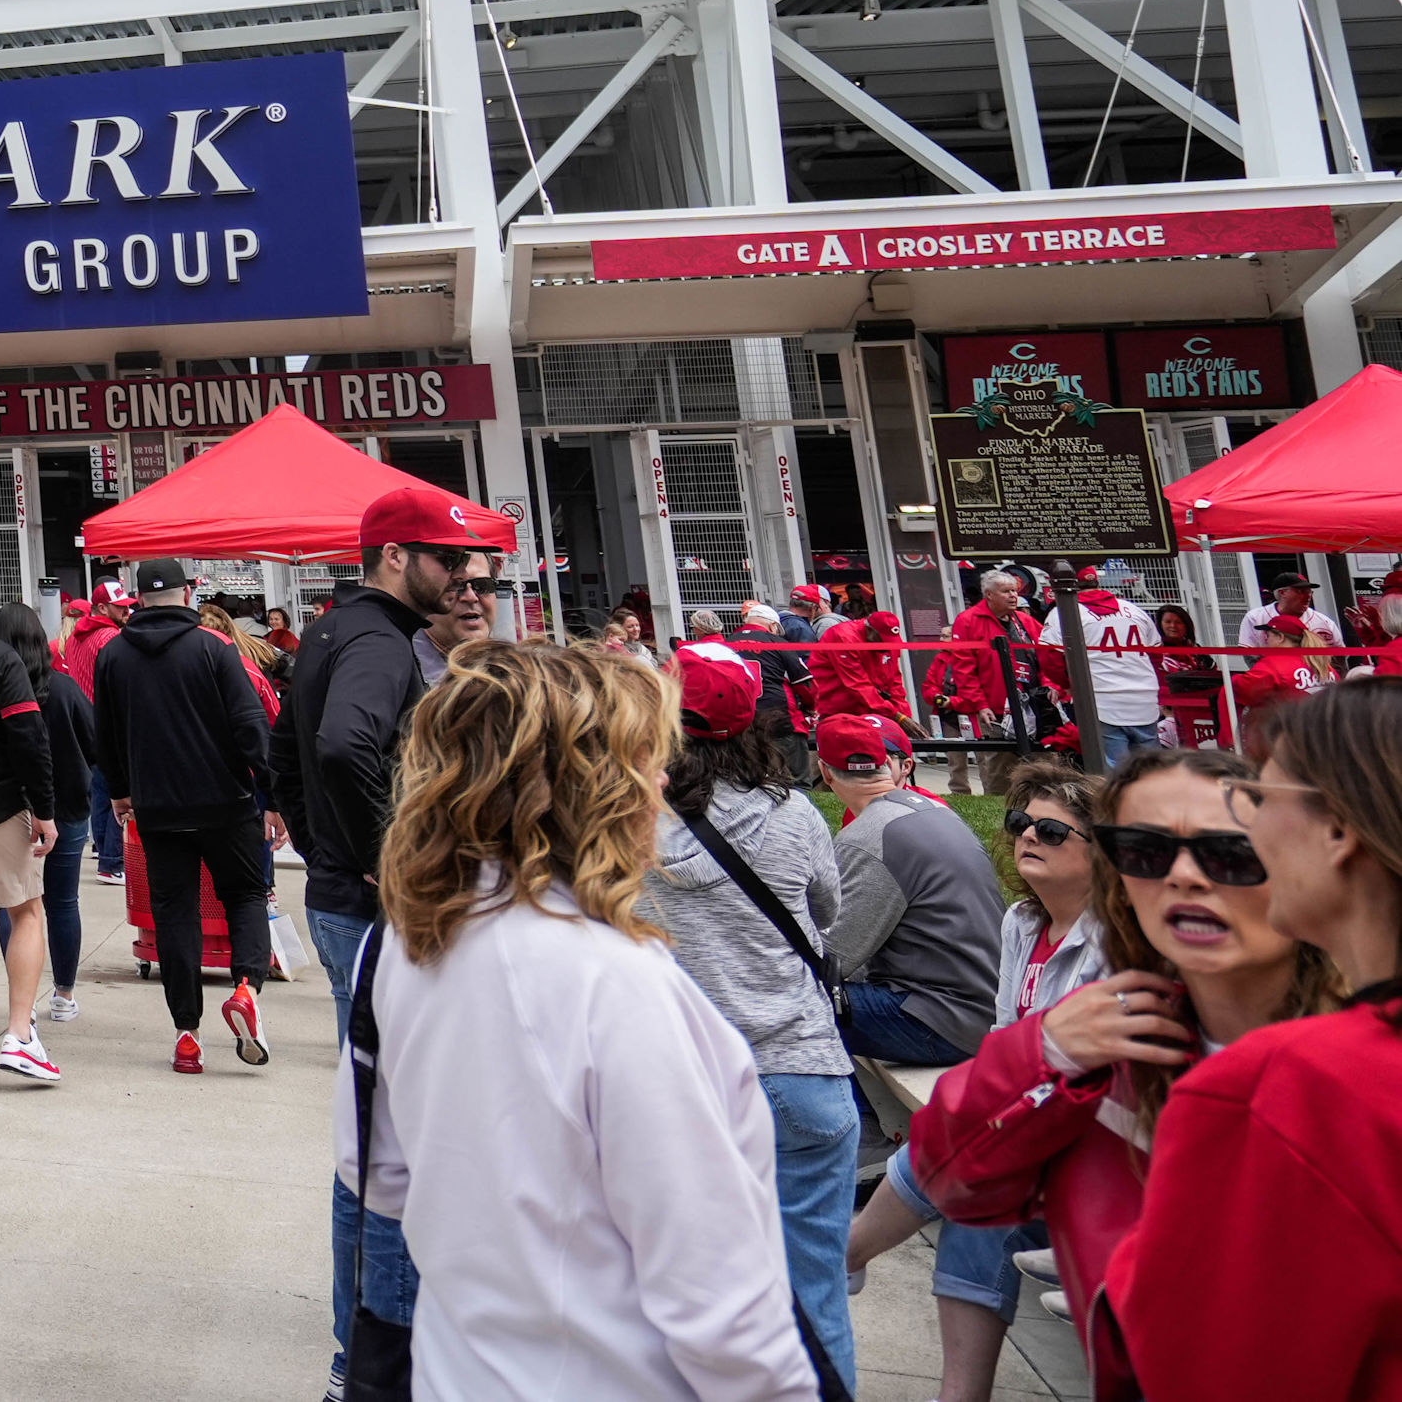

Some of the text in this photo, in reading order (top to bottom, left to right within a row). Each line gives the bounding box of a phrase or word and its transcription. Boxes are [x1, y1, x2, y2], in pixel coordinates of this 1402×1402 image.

[737, 225, 1166, 267] GATE A CROSLEY TERRACE
[24, 228, 260, 295] GROUP
[991, 362, 1060, 379] WELCOME
[1164, 357, 1238, 374] WELCOME
[1013, 389, 1046, 401] OHIO
[1146, 369, 1263, 398] REDS FANS
[21, 386, 91, 431] THE
[104, 375, 325, 429] CINCINNATI
[339, 370, 447, 419] REDS
[1008, 404, 1058, 413] HISTORICAL
[1015, 412, 1053, 420] MARKER
[977, 443, 1105, 456] OPENING DAY PARADE
[989, 436, 1090, 448] FINDLAY MARKET
[652, 456, 668, 519] OPEN 4
[778, 455, 796, 517] OPEN 3
[15, 474, 25, 529] OPEN 7
[1099, 624, 1146, 659] 44
